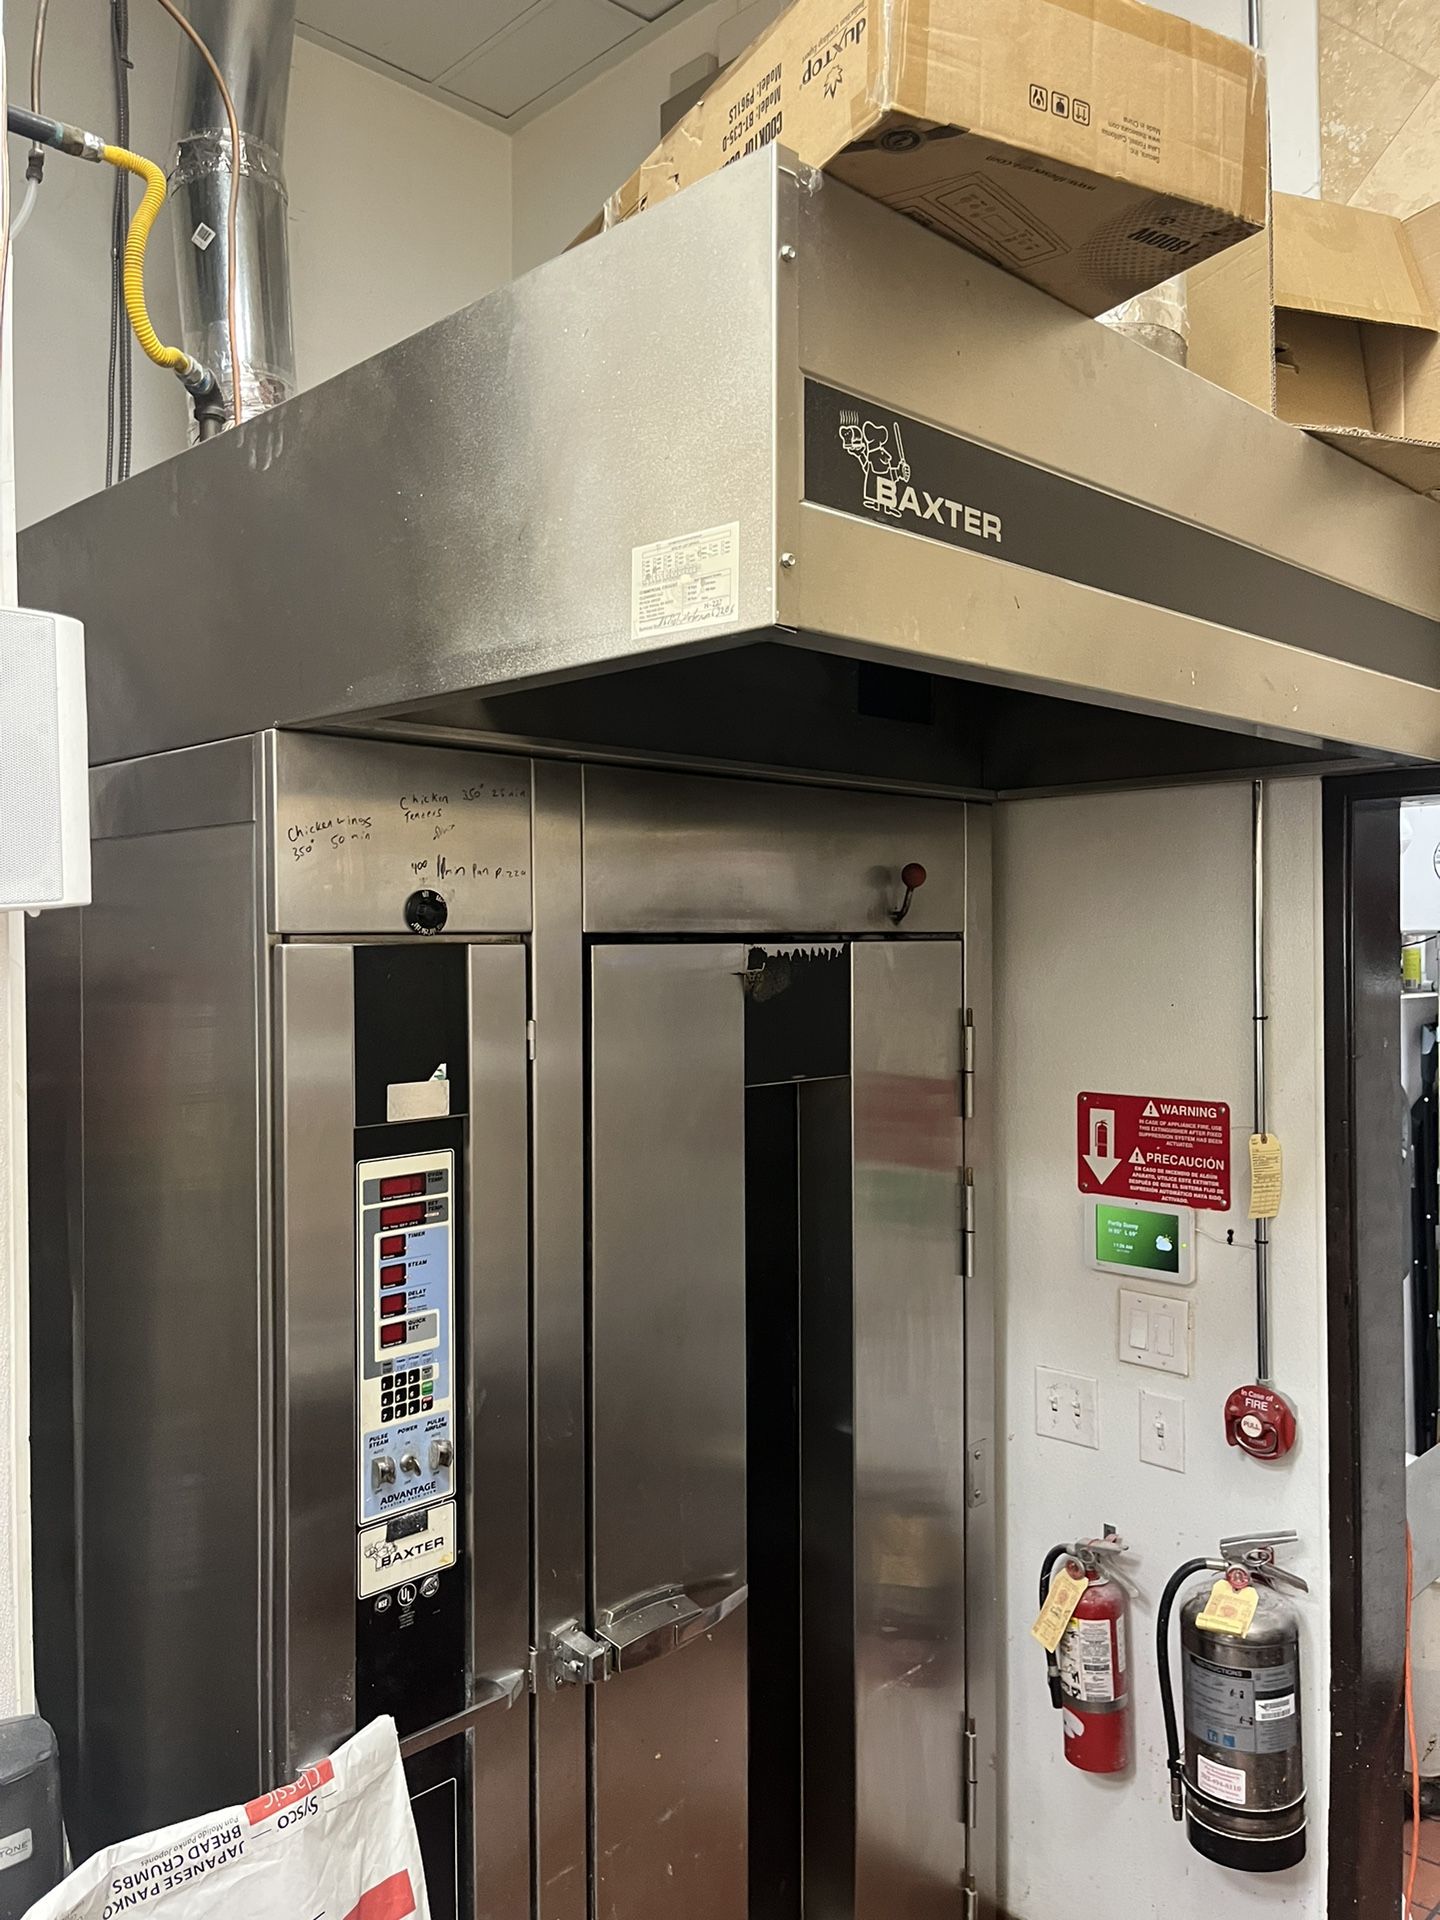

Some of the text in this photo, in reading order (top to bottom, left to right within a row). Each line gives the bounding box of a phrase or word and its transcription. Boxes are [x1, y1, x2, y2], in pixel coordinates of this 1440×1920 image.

[729, 62, 782, 125] Model: P961LS
[756, 84, 781, 119] Model:
[876, 476, 1002, 543] BAXTER
[331, 834, 345, 849] 50
[1160, 1104, 1217, 1119] WARNING
[1146, 1152, 1225, 1171] PRECAUCIÓN
[1180, 1184, 1203, 1192] SISTEMA
[408, 1231, 426, 1239] TIMER
[408, 1260, 428, 1268] STEAM
[408, 1288, 426, 1297] DELAY
[1248, 1391, 1265, 1400] Case
[1245, 1397, 1268, 1412] FIRE
[424, 1422, 447, 1432] AIRFLOW
[426, 1416, 445, 1426] PULSE
[397, 1424, 418, 1434] POWER
[369, 1432, 389, 1443] PULSE
[369, 1439, 389, 1449] STEAM
[380, 1480, 437, 1506] ADVANTAGE
[381, 1537, 444, 1567] BAXTER
[401, 1587, 412, 1602] UL
[264, 1767, 320, 1809] Classic
[277, 1795, 319, 1829] Sysco
[198, 1823, 223, 1839] Molido
[173, 1835, 197, 1852] Panko
[112, 1825, 242, 1894] BREAD CRUMBS
[165, 1840, 245, 1890] JAPANESE
[102, 1883, 160, 1920] PANKO
